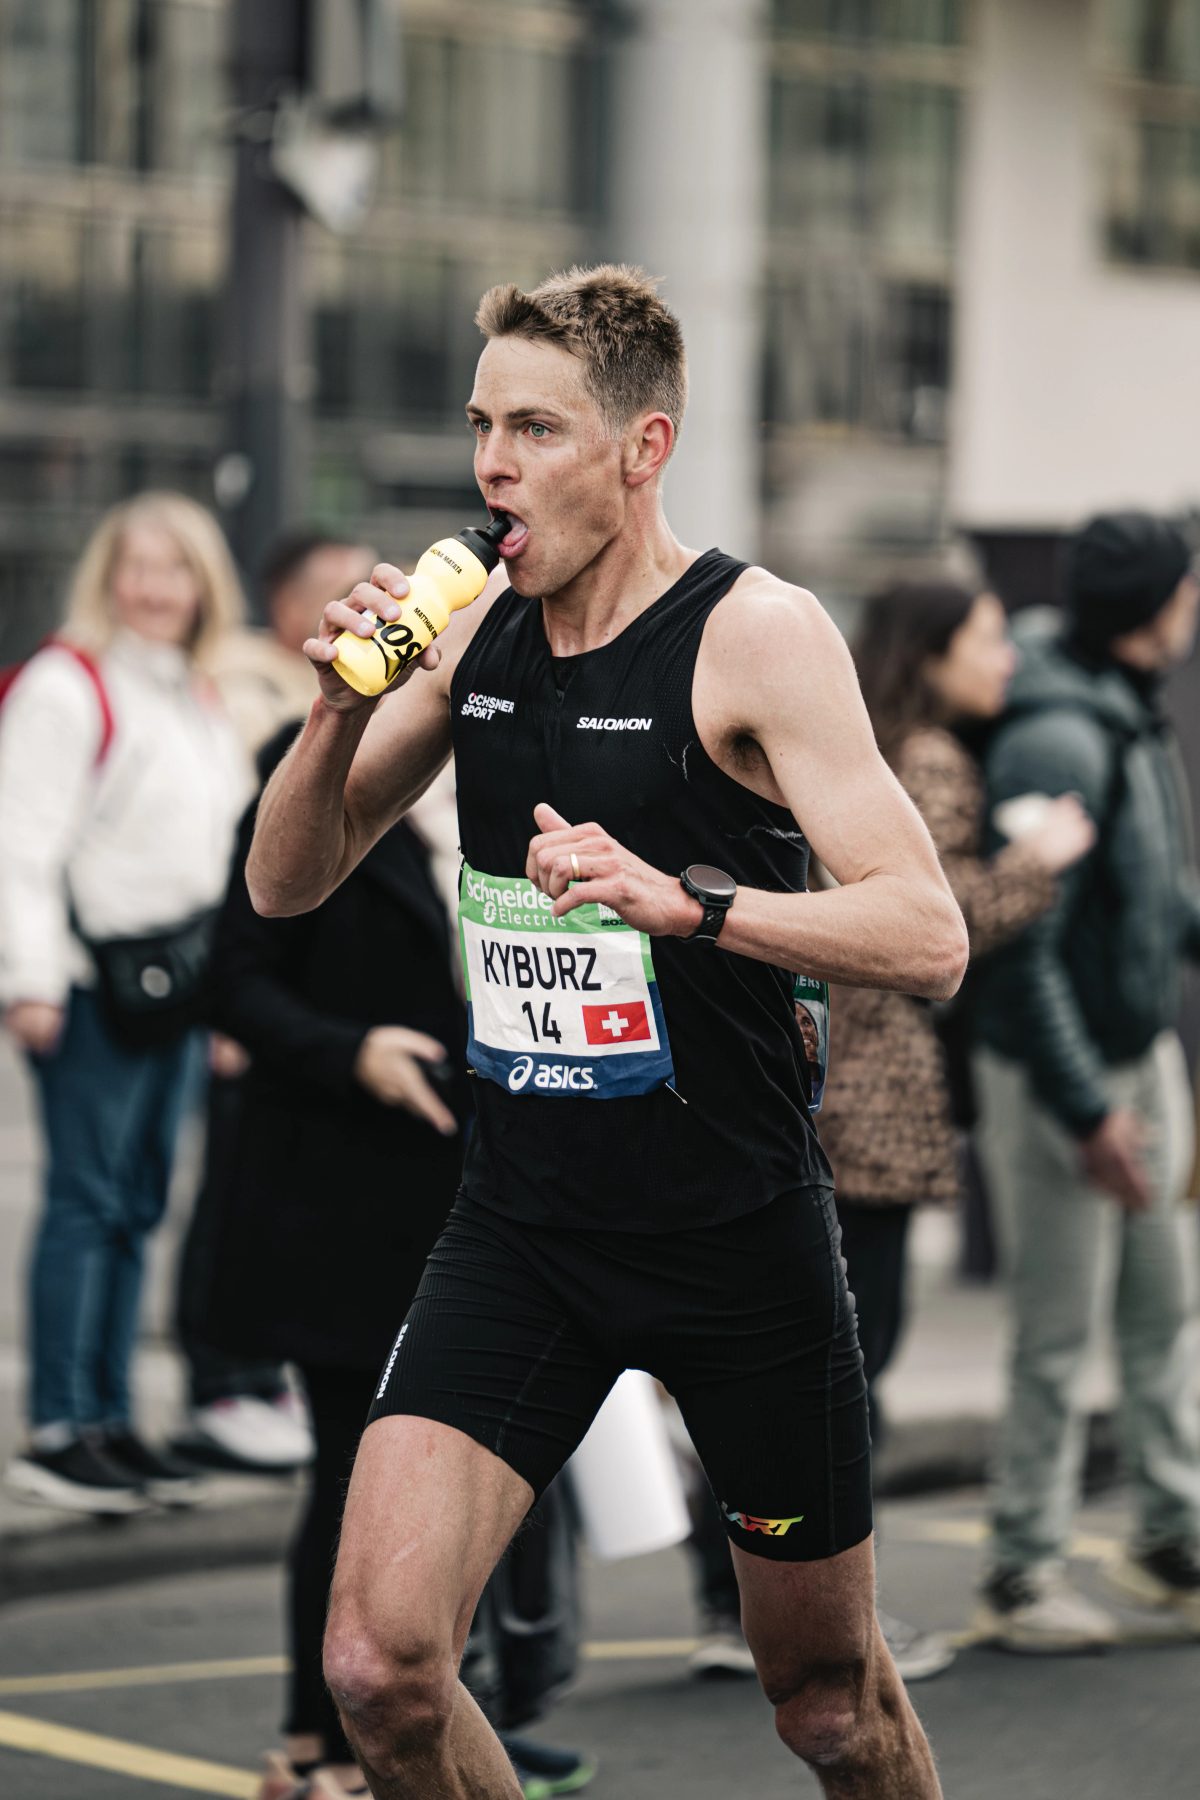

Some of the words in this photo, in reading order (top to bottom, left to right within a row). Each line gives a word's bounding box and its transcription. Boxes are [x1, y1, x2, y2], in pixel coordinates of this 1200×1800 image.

[443, 555, 463, 575] MATATA
[413, 606, 435, 635] MATTHIAS
[460, 703, 496, 721] SPORT
[467, 692, 515, 714] OCHSNER
[576, 716, 653, 731] SALOMON
[466, 874, 556, 910] Schneide
[499, 906, 567, 928] Electric
[481, 939, 602, 992] KYBURZ
[521, 1001, 562, 1044] 14
